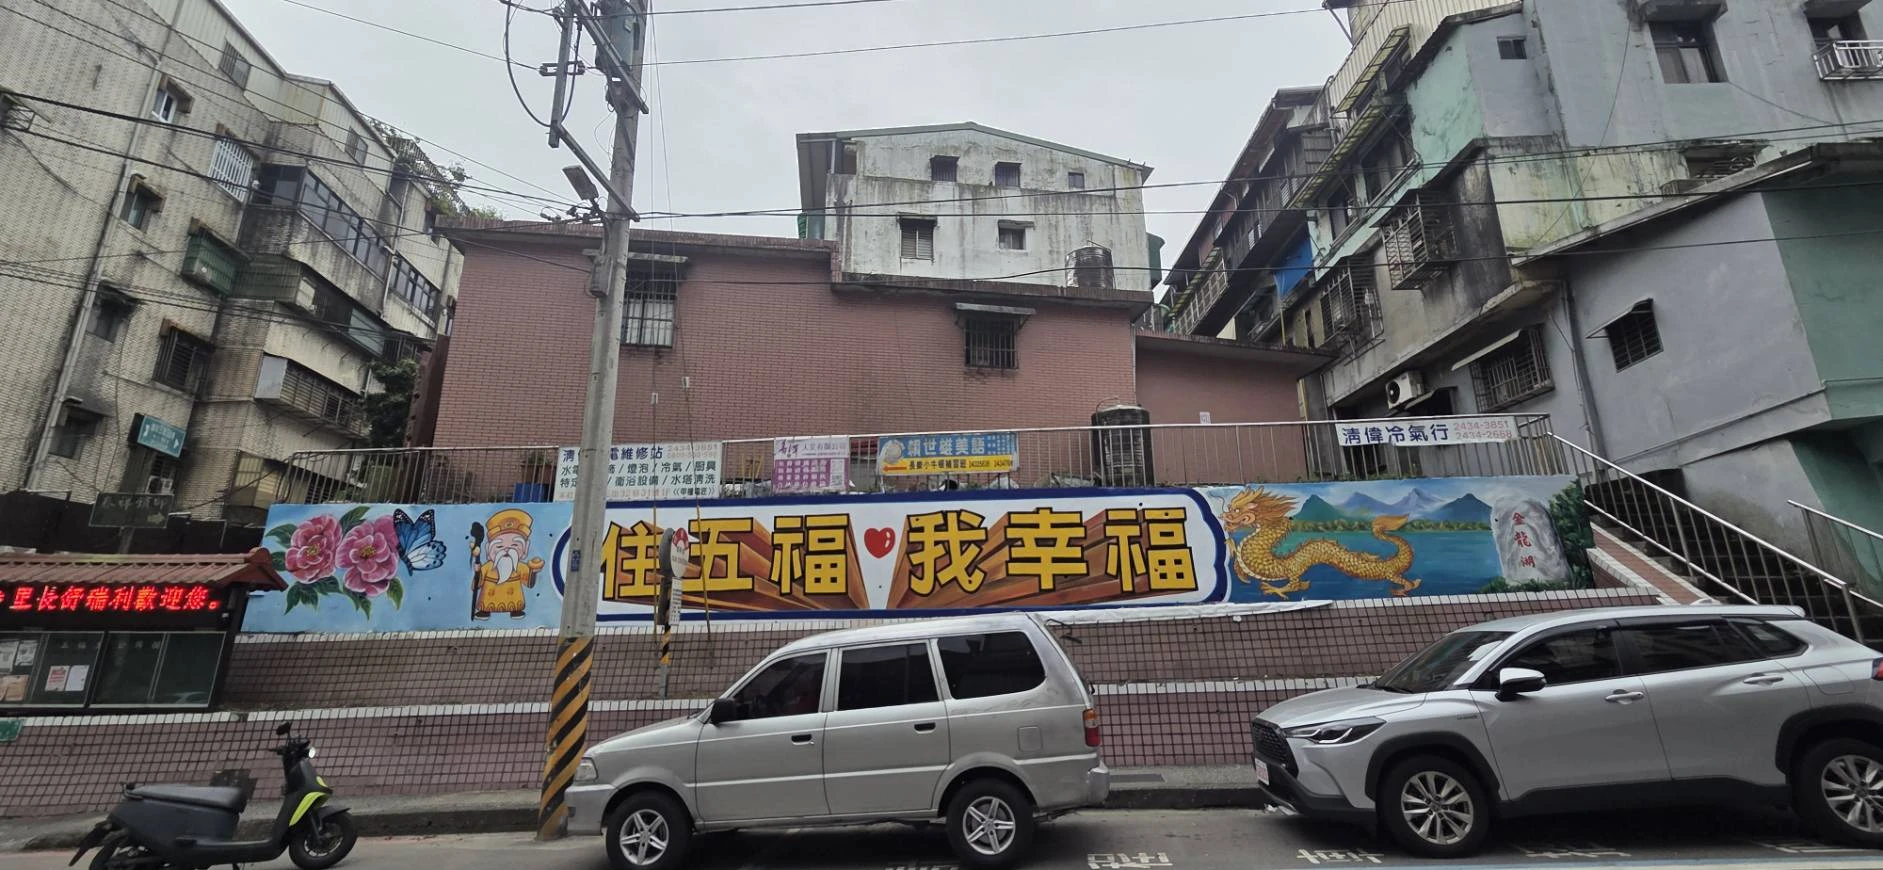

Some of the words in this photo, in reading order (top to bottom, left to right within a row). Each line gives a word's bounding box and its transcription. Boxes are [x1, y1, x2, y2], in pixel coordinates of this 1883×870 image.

[1342, 424, 1449, 444] 清偉冷氣行
[1453, 420, 1509, 431] 2434-3851
[563, 447, 664, 463] 清電維修站
[600, 513, 850, 600] 住五福
[907, 506, 1199, 596] 我幸福
[1512, 512, 1536, 568] 金龍湖
